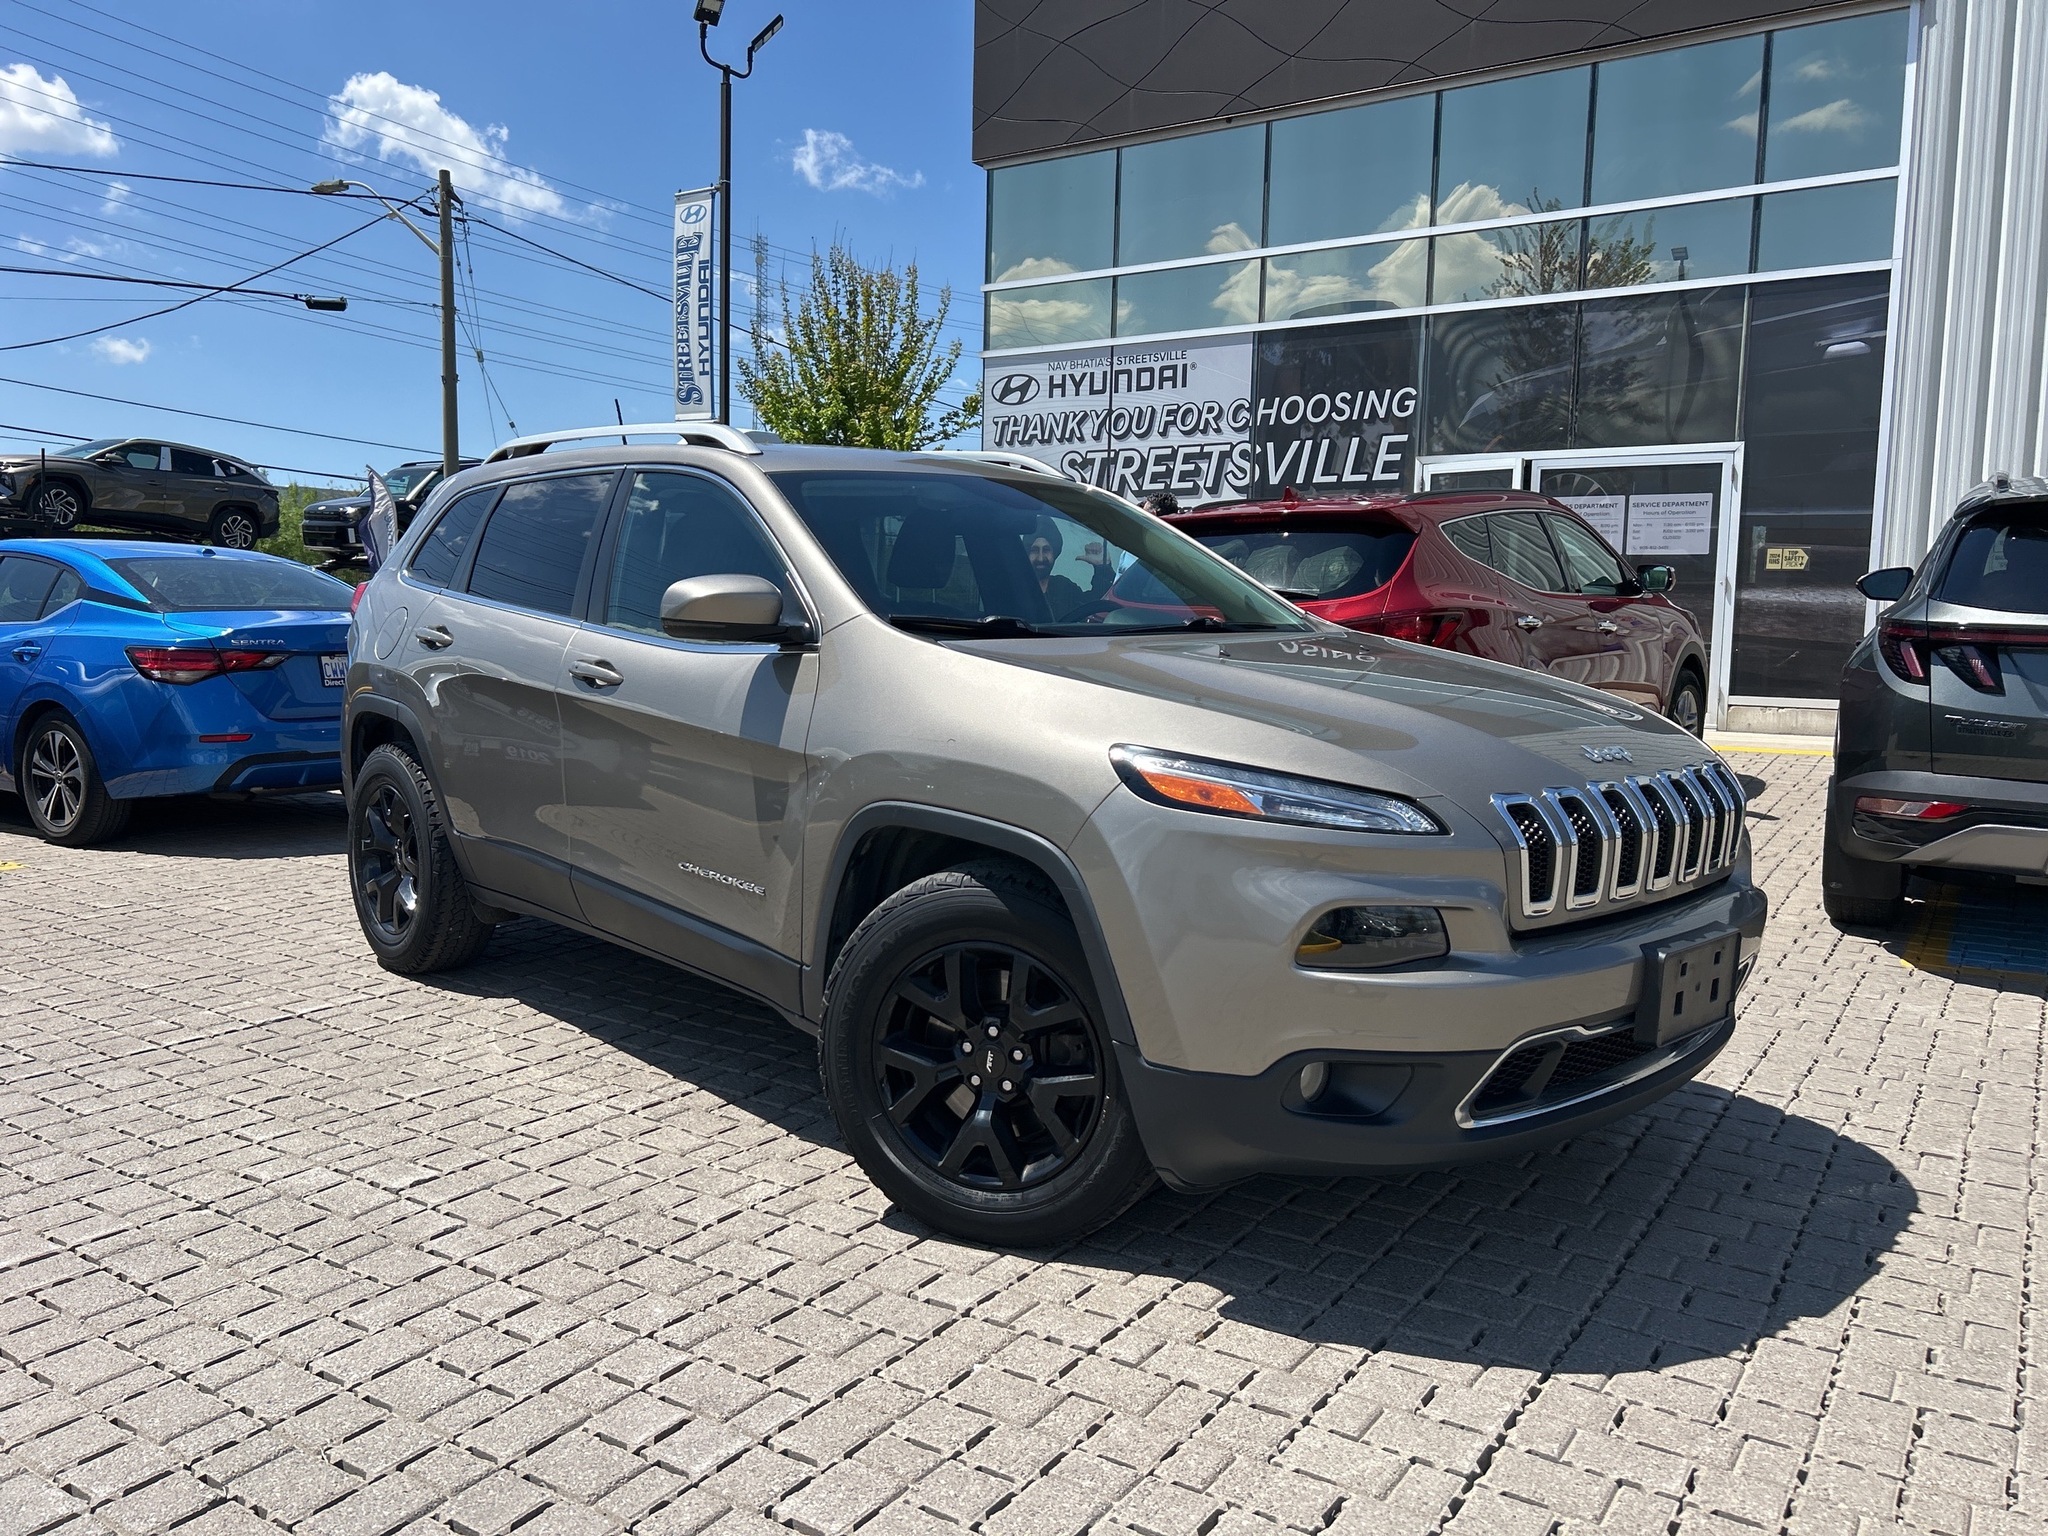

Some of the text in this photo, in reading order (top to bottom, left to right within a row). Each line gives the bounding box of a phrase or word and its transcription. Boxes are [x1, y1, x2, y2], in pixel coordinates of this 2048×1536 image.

[676, 232, 704, 406] STREETSVILLE
[698, 259, 710, 376] HYUNDAI
[1048, 350, 1188, 372] NAV BHATIA'S STREETSVILLE
[993, 387, 1417, 447] THANK YOU FOR CHOOSING
[1061, 434, 1409, 495] STREETSVILLE
[1580, 744, 1633, 763] Jeep
[678, 861, 766, 896] CHEROKEE
